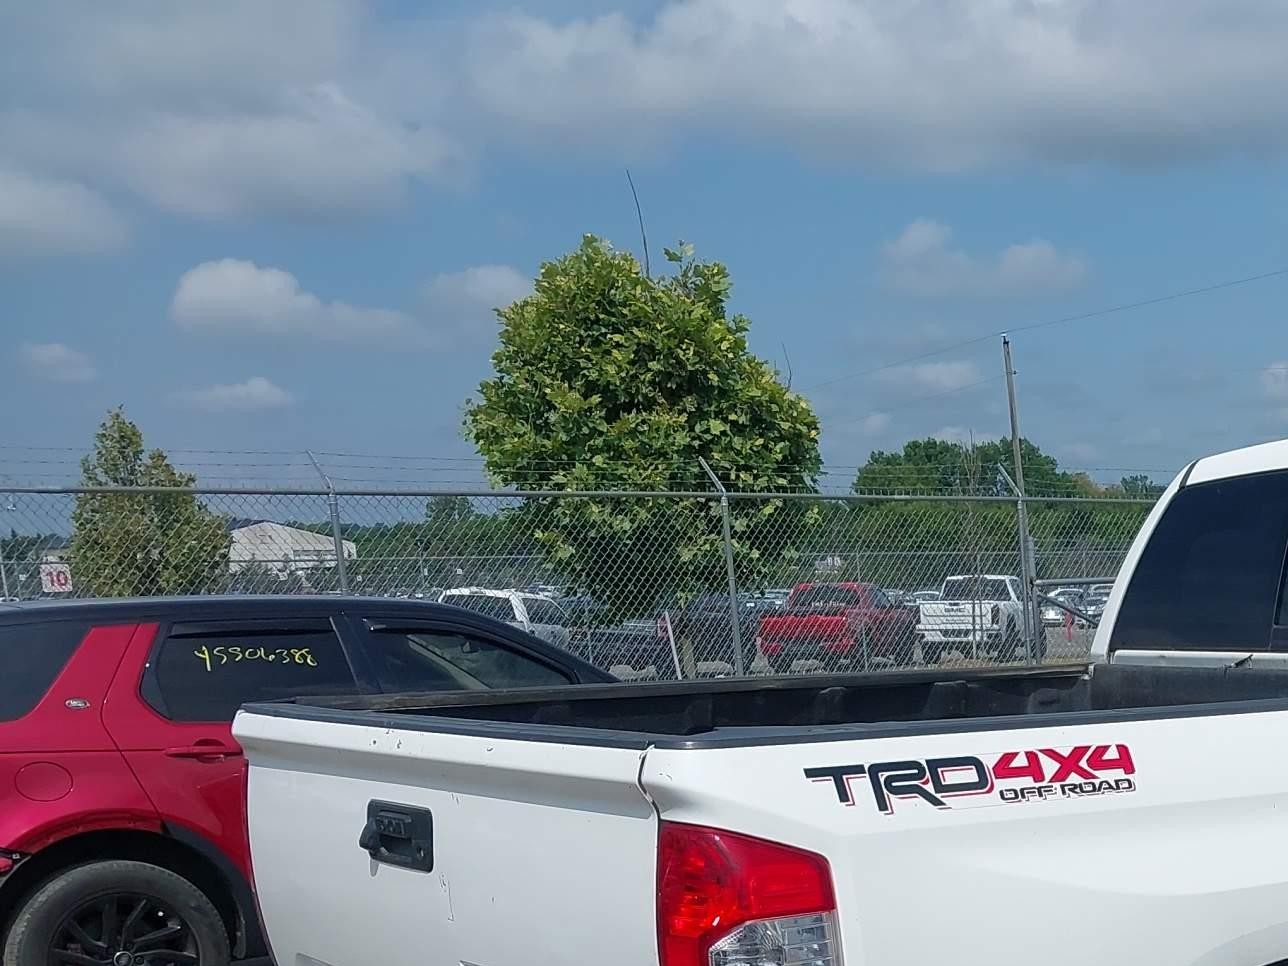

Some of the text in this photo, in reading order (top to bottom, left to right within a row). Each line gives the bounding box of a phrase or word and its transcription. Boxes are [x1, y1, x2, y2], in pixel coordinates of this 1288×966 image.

[46, 570, 68, 587] 10
[803, 755, 995, 815] TRD
[1000, 777, 1136, 805] OFF ROAD
